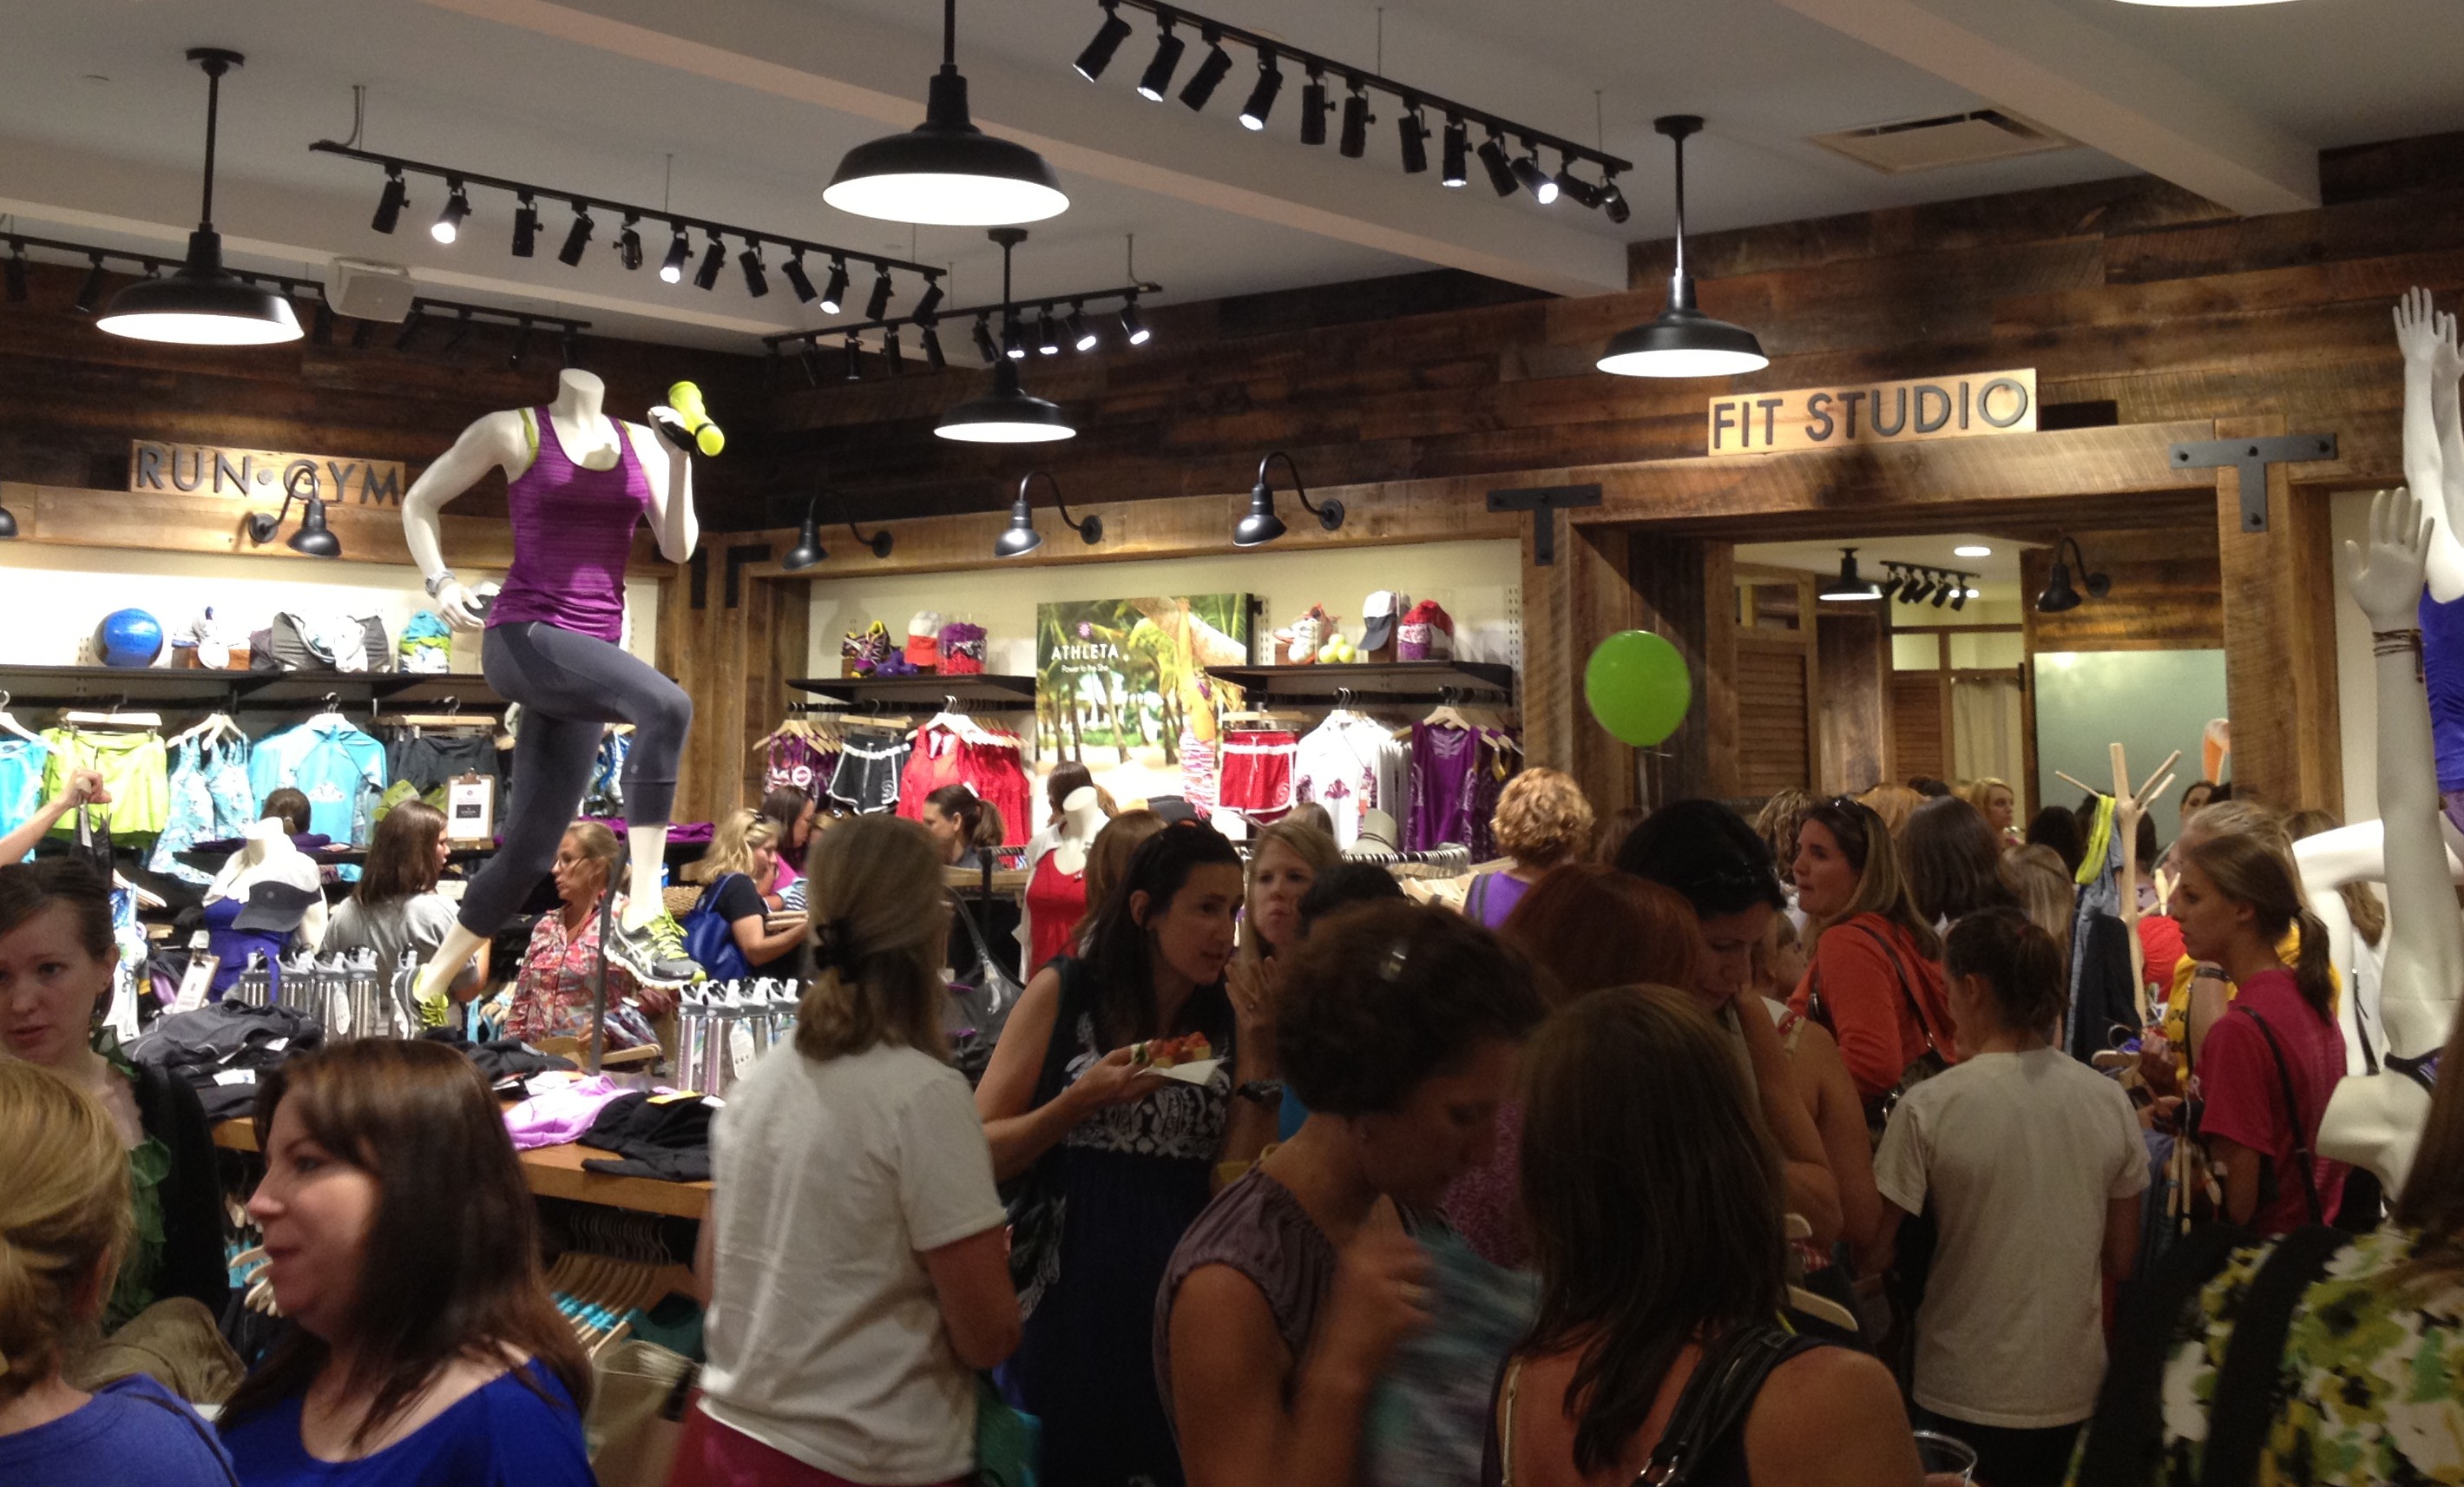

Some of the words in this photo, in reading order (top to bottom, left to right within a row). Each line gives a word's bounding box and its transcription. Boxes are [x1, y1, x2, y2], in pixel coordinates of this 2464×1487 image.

[1713, 398, 1784, 450] FIT
[1805, 378, 2028, 442] STUDIO
[137, 446, 252, 497] RUN
[283, 458, 400, 506] GYM
[1050, 643, 1120, 661] ATHLETA
